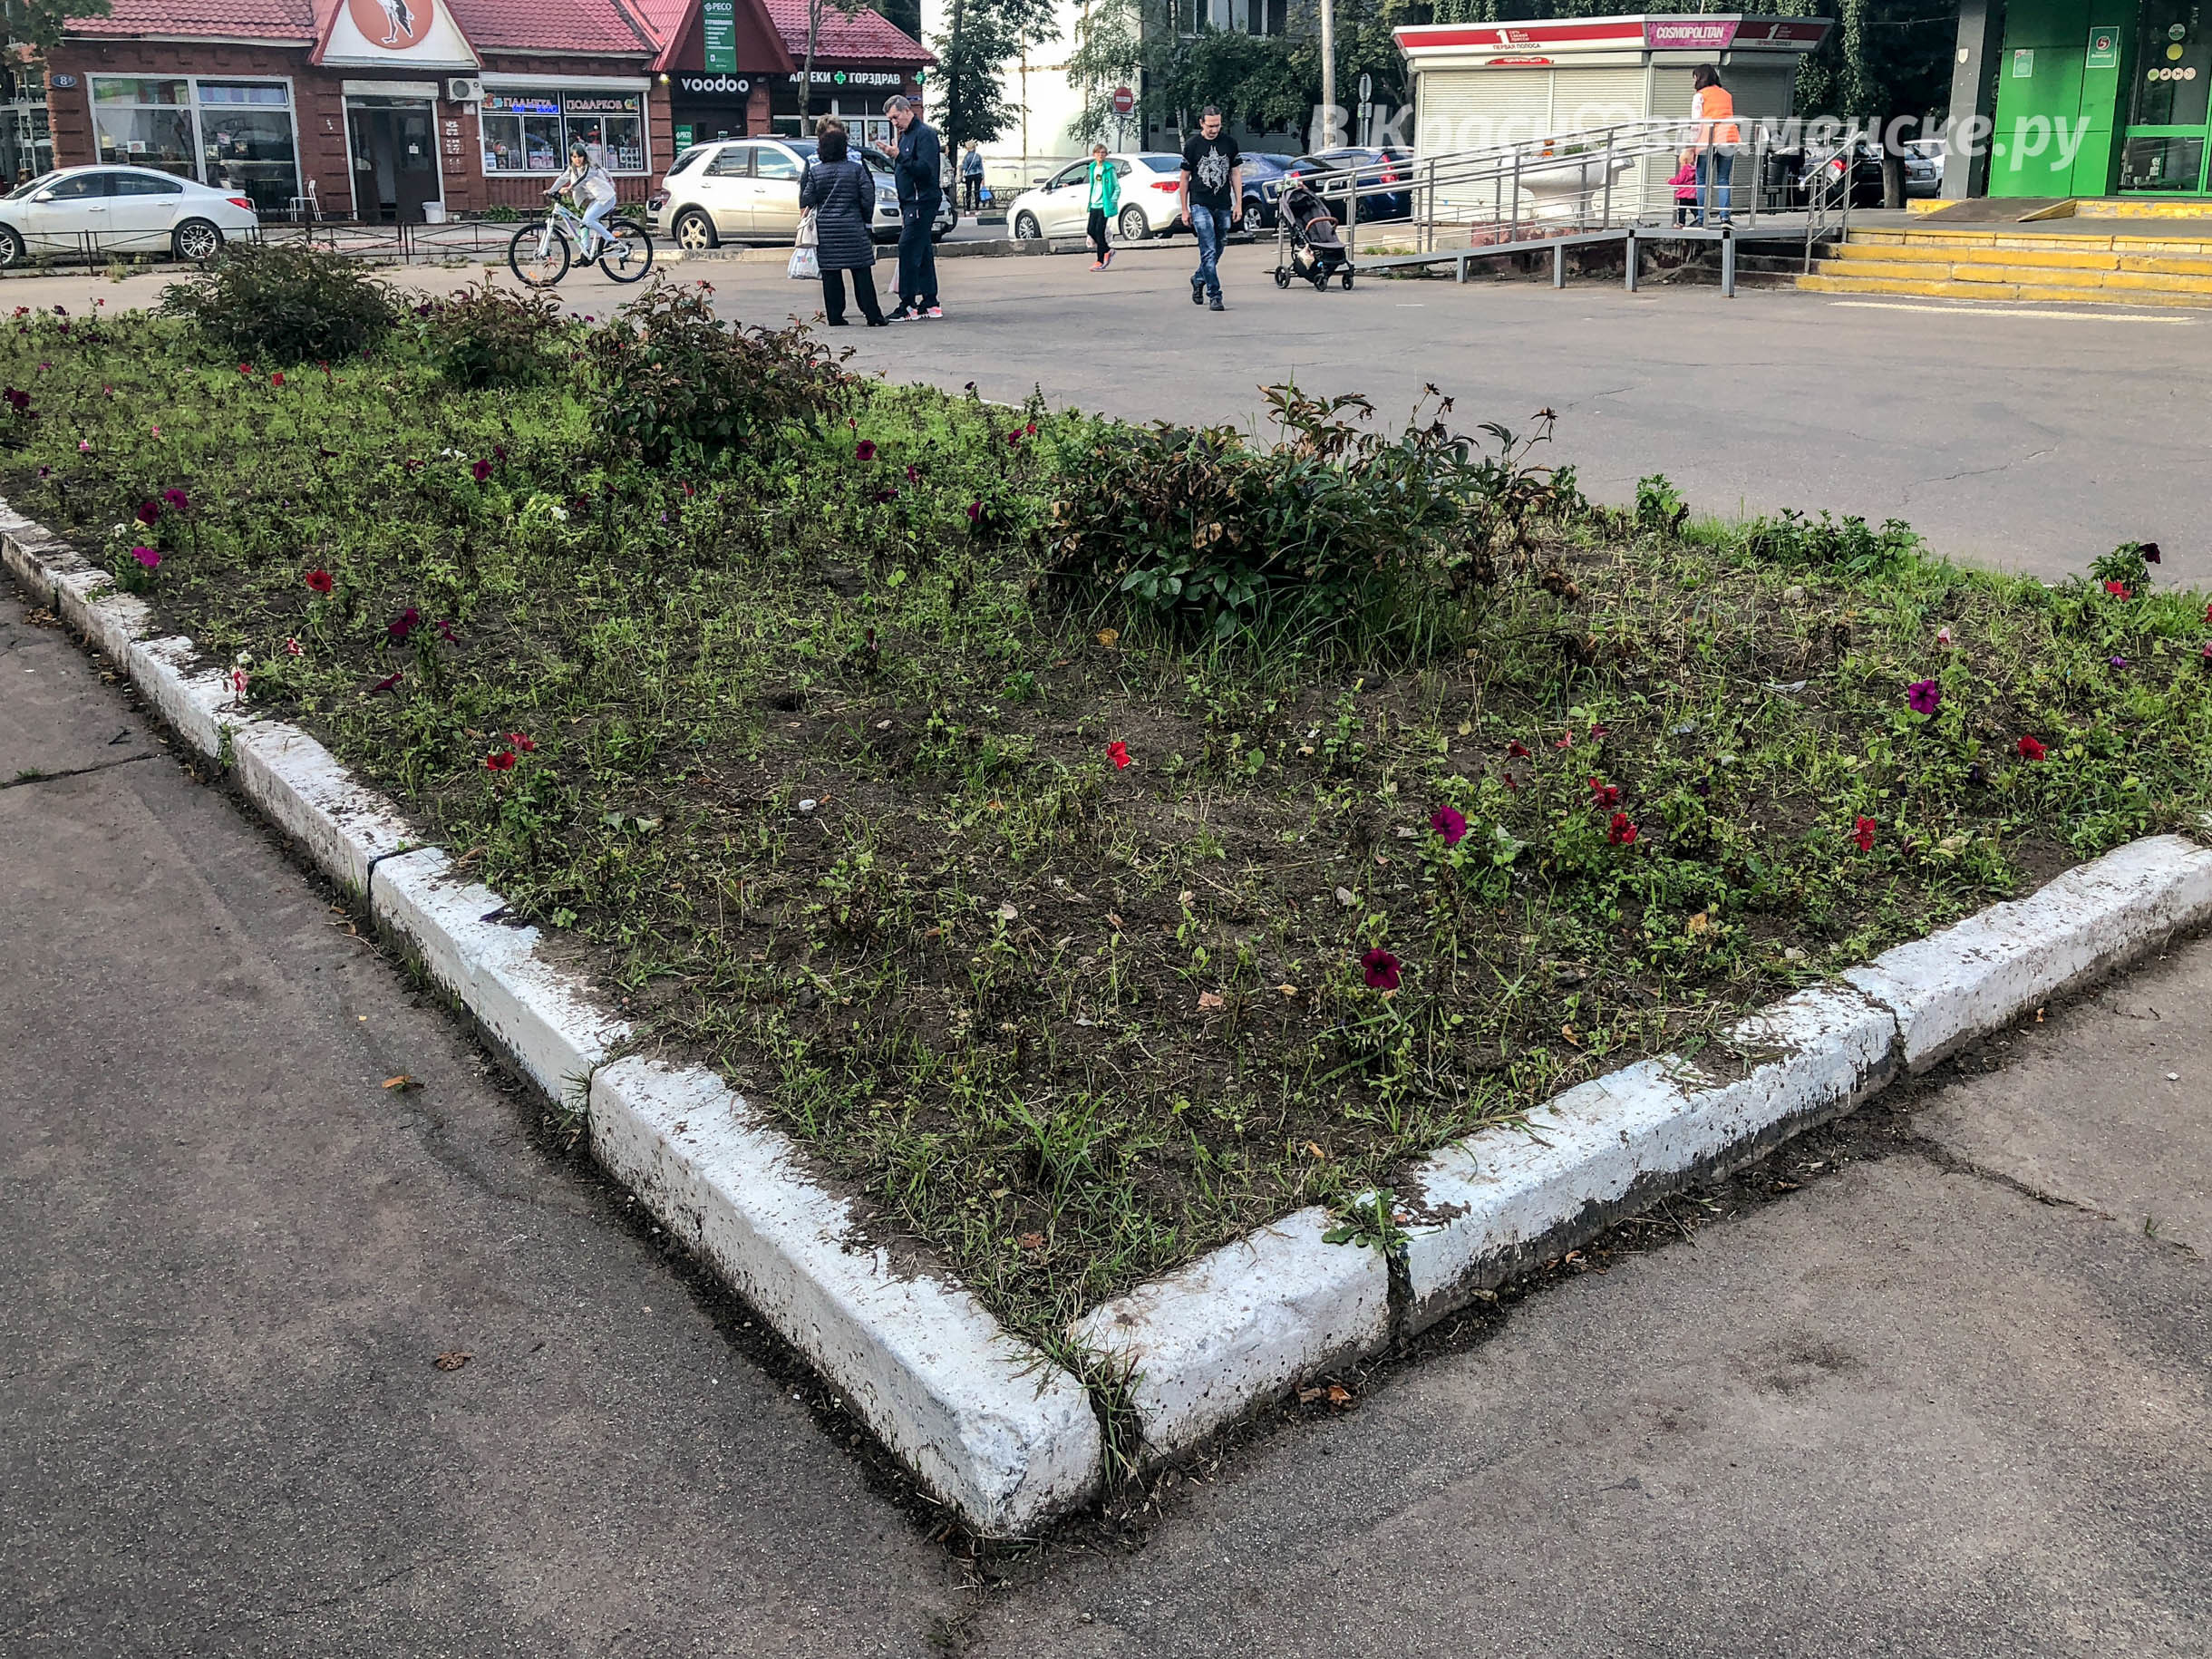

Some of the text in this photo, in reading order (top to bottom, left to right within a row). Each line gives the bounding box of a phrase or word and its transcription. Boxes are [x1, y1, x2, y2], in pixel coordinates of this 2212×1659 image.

[1656, 26, 1724, 39] COSMOPOLITAN
[682, 74, 750, 92] voodoo
[790, 72, 900, 86] АПЕКИ ГОРЗДРАВ
[567, 99, 623, 110] ПОДАРКОВ
